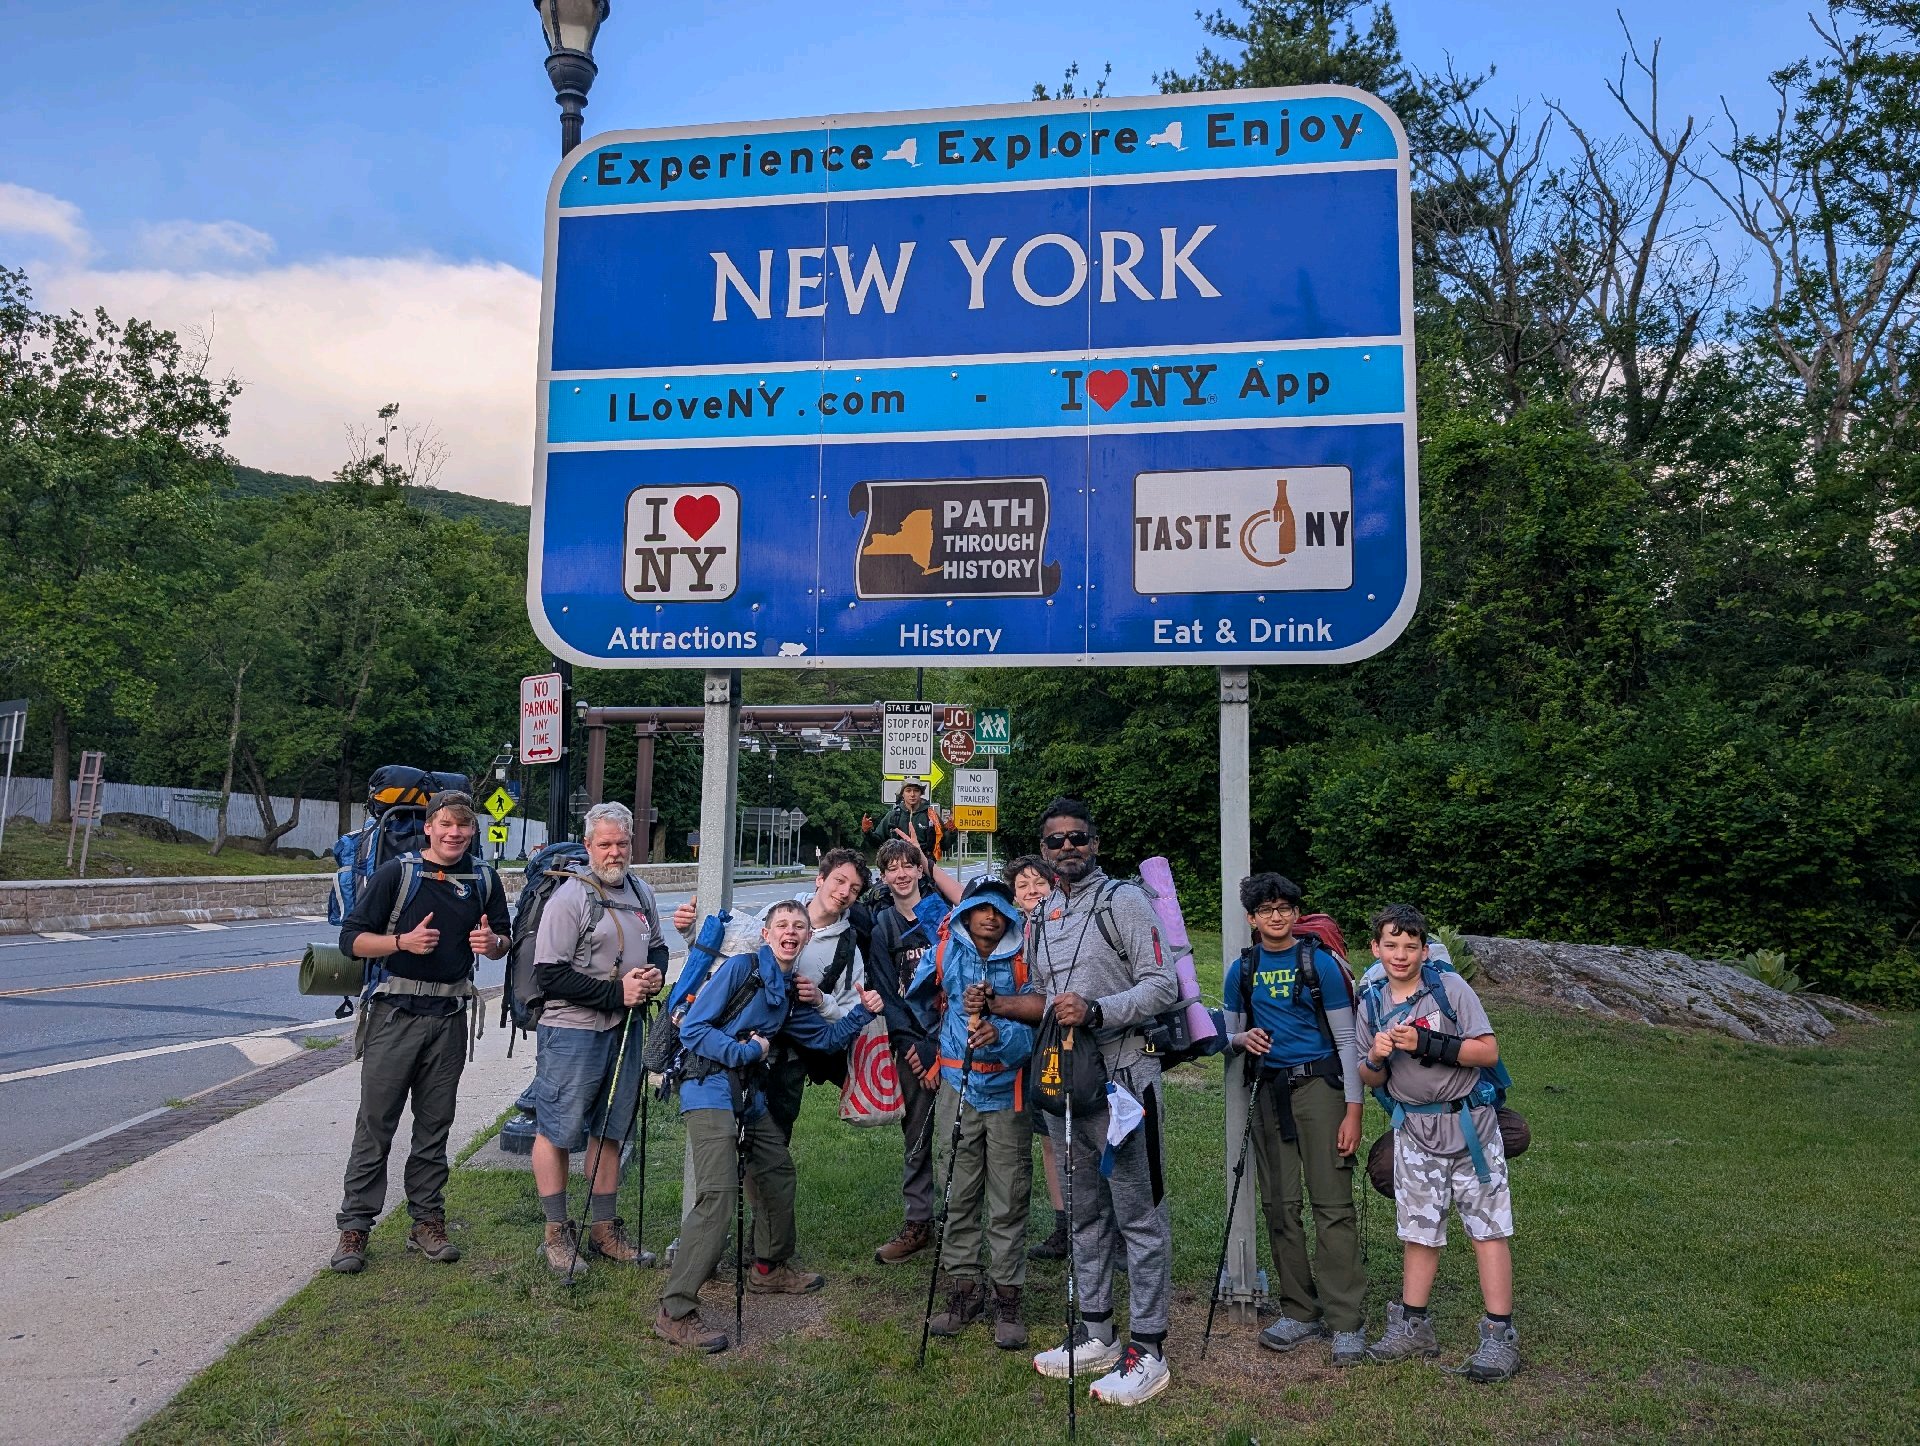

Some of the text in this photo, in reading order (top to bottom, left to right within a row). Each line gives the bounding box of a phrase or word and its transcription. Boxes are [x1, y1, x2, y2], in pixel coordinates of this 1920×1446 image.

[597, 109, 1364, 190] Experience Explore Enjoy
[709, 225, 1223, 321] NEW YORK
[1239, 367, 1330, 405] App
[644, 497, 669, 541] I
[943, 499, 1034, 528] PATH
[1135, 511, 1350, 552] TASTE NY
[943, 533, 1034, 553] THROUGH
[943, 559, 1034, 579] HISTORY
[608, 626, 757, 650] Attractions
[900, 624, 1002, 652] History
[1154, 617, 1333, 644] Eat & Drink
[534, 682, 548, 698] NO
[525, 699, 558, 718] PARKING
[914, 704, 931, 712] LAW
[534, 719, 548, 731] ANY
[887, 719, 930, 728] STOP FOR
[945, 710, 970, 726] JCT
[533, 734, 549, 745] TIME
[888, 732, 928, 742] STOPPED
[890, 746, 926, 755] SCHOOL
[980, 745, 1007, 753] XING
[899, 760, 917, 769] BUS
[969, 774, 982, 782] NO
[957, 785, 980, 793] TRUCKS
[960, 795, 990, 803] TRAILERS
[1260, 969, 1299, 985] WIL
